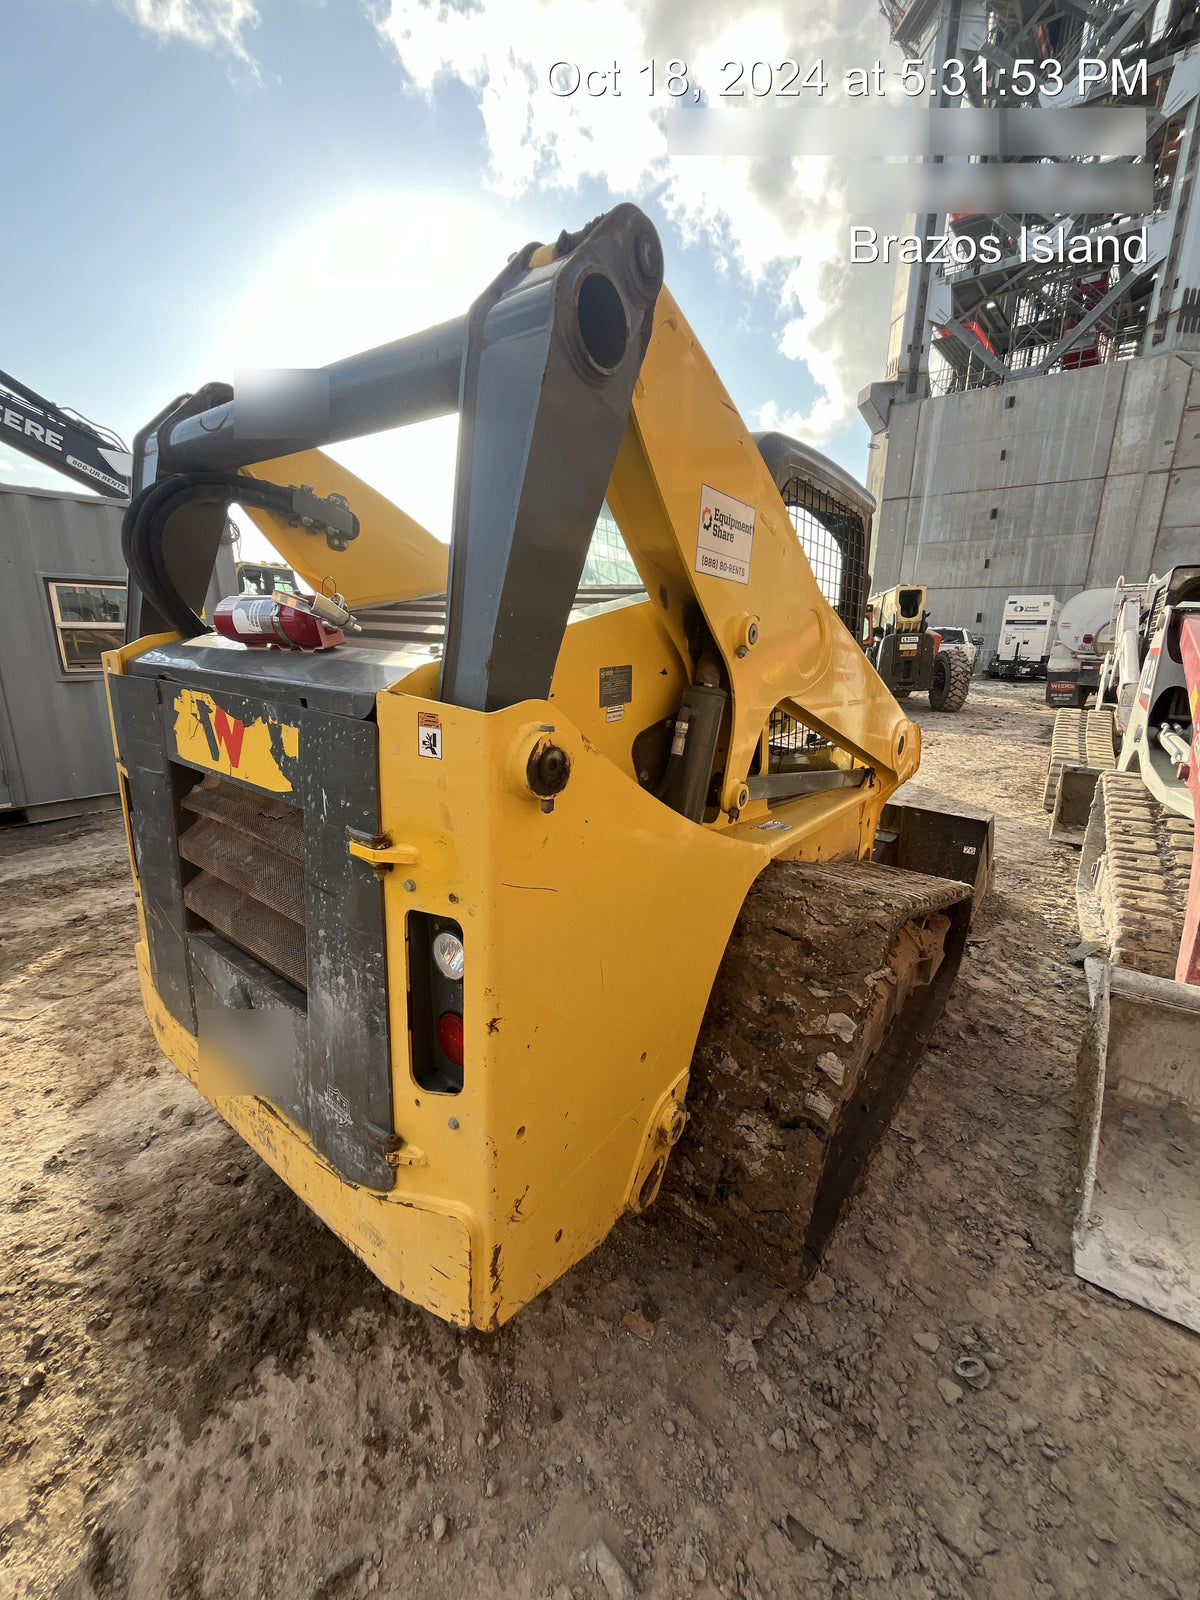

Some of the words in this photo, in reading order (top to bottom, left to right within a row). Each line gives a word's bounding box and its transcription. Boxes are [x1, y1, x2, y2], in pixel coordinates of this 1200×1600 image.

[0, 405, 64, 452] ERE
[71, 459, 126, 492] 800-UR-RENTS
[713, 524, 734, 542] Share
[714, 508, 752, 535] Equipment
[701, 555, 719, 570] (888)
